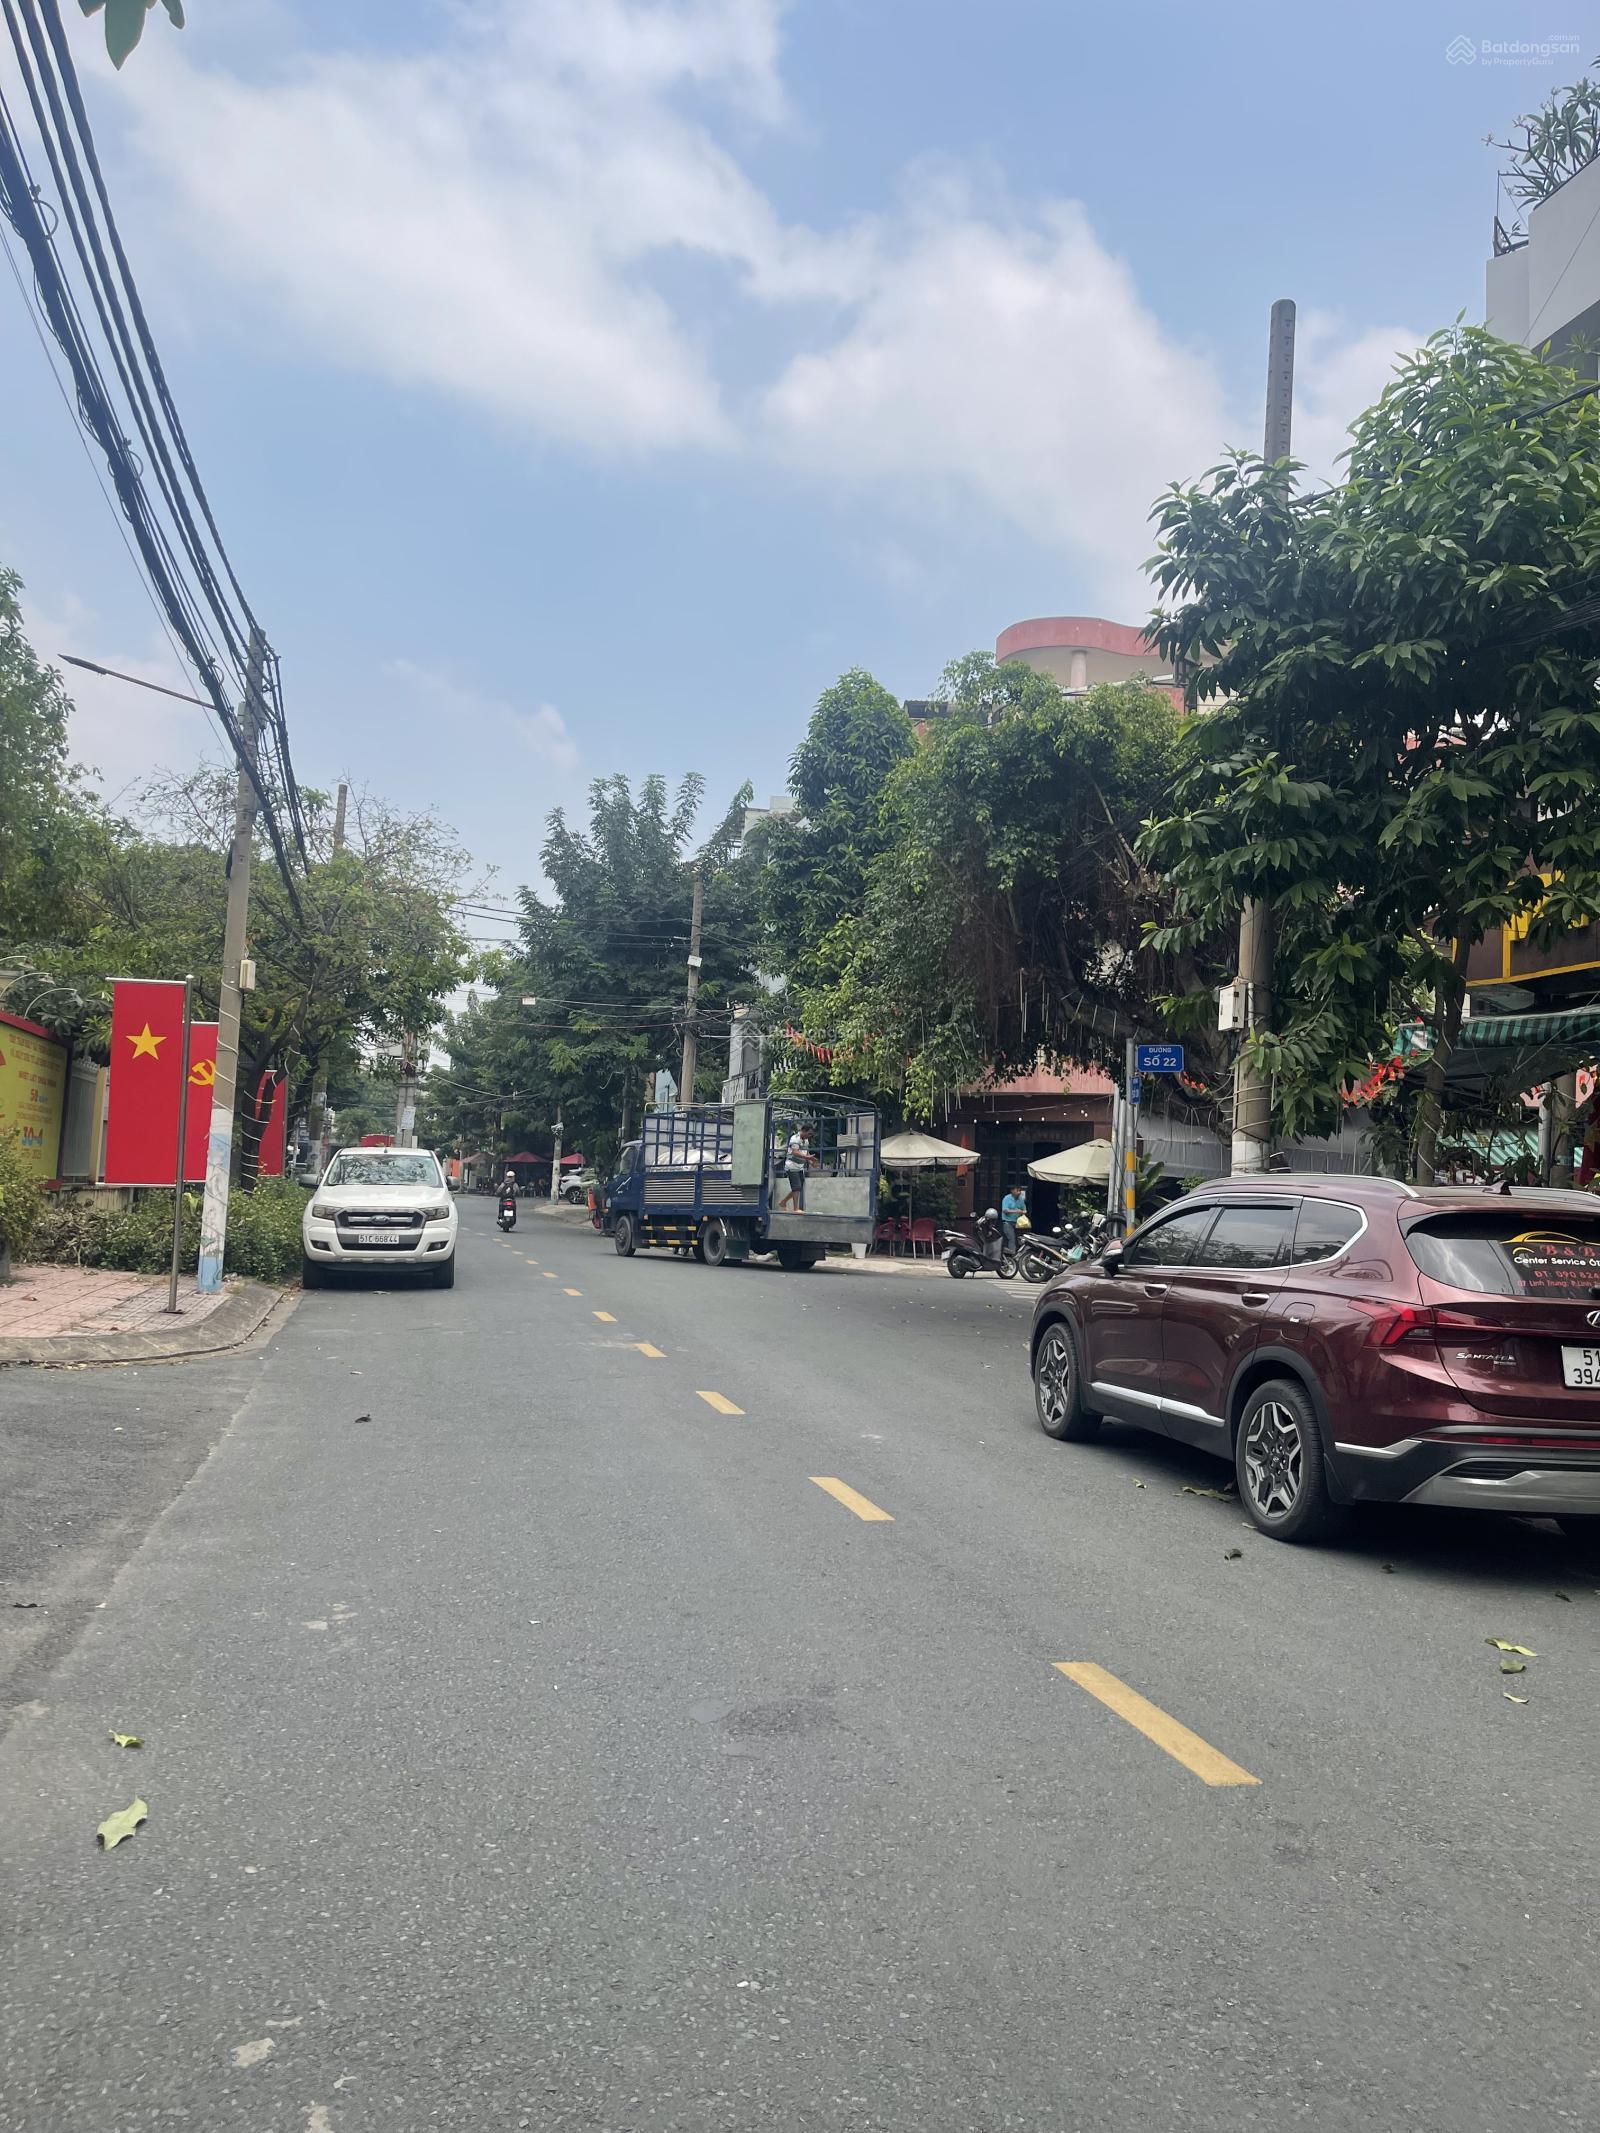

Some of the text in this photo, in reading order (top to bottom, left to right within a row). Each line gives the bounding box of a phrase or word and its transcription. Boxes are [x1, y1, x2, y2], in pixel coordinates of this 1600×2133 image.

[1143, 1054, 1177, 1067] SỐ 22
[1563, 1246, 1575, 1256] &
[1514, 1256, 1548, 1265] Center
[1551, 1257, 1587, 1266] Service
